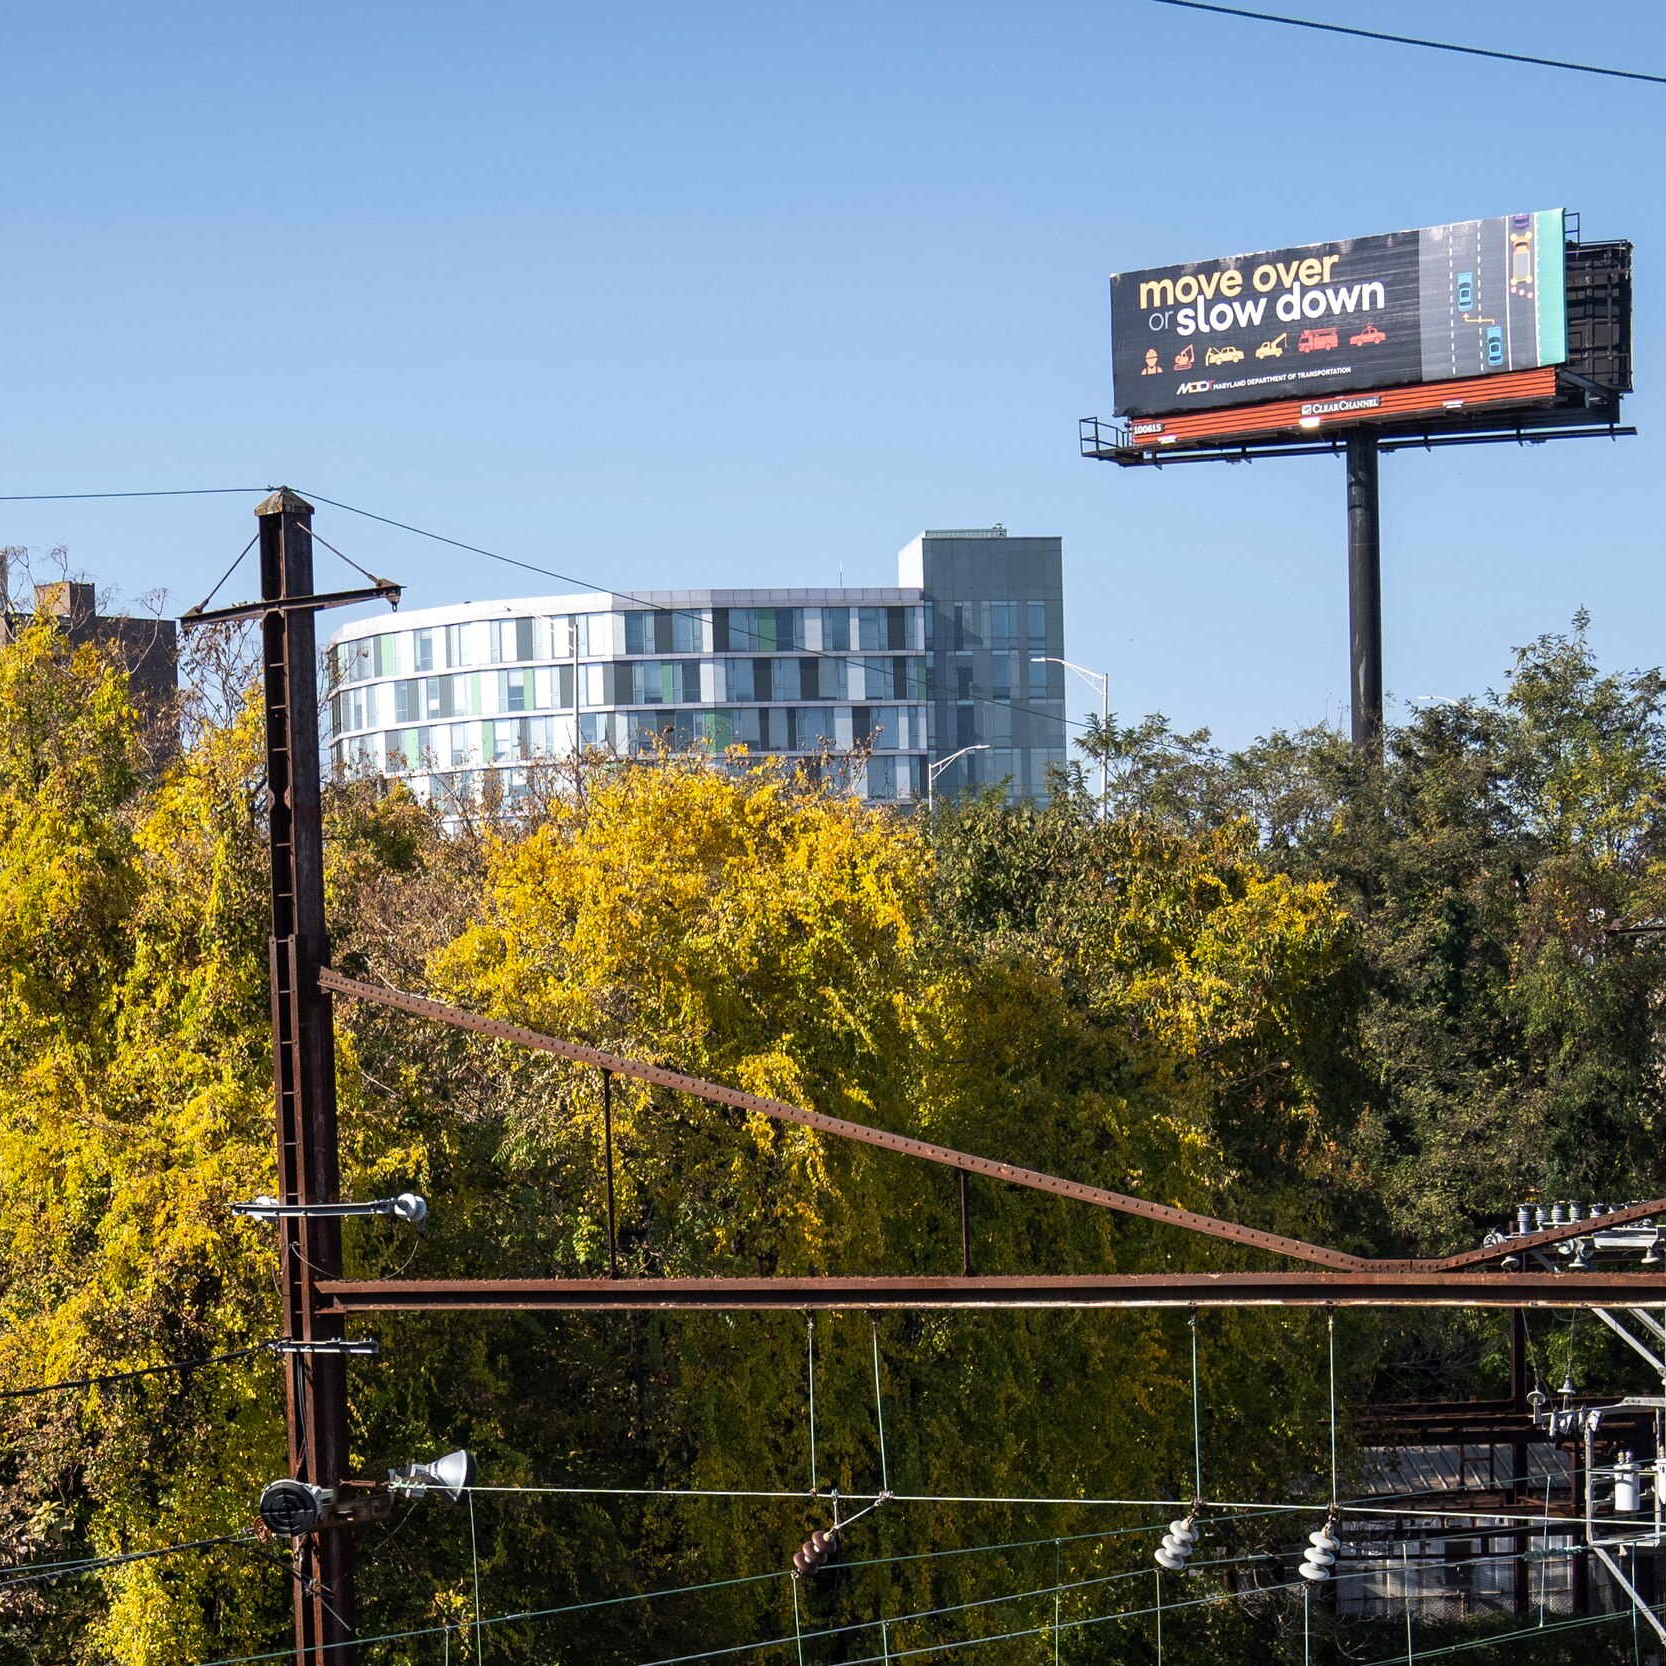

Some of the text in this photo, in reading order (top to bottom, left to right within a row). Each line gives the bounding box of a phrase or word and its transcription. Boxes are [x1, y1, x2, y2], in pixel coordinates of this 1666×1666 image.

[1139, 254, 1339, 310] move over
[1148, 280, 1385, 336] or slow down
[1213, 380, 1246, 391] MARYLAND
[1247, 374, 1286, 386] DEPARTMENT
[1287, 373, 1297, 381] OF
[1297, 367, 1351, 379] TRANSPORTATION
[1134, 424, 1162, 435] 100615
